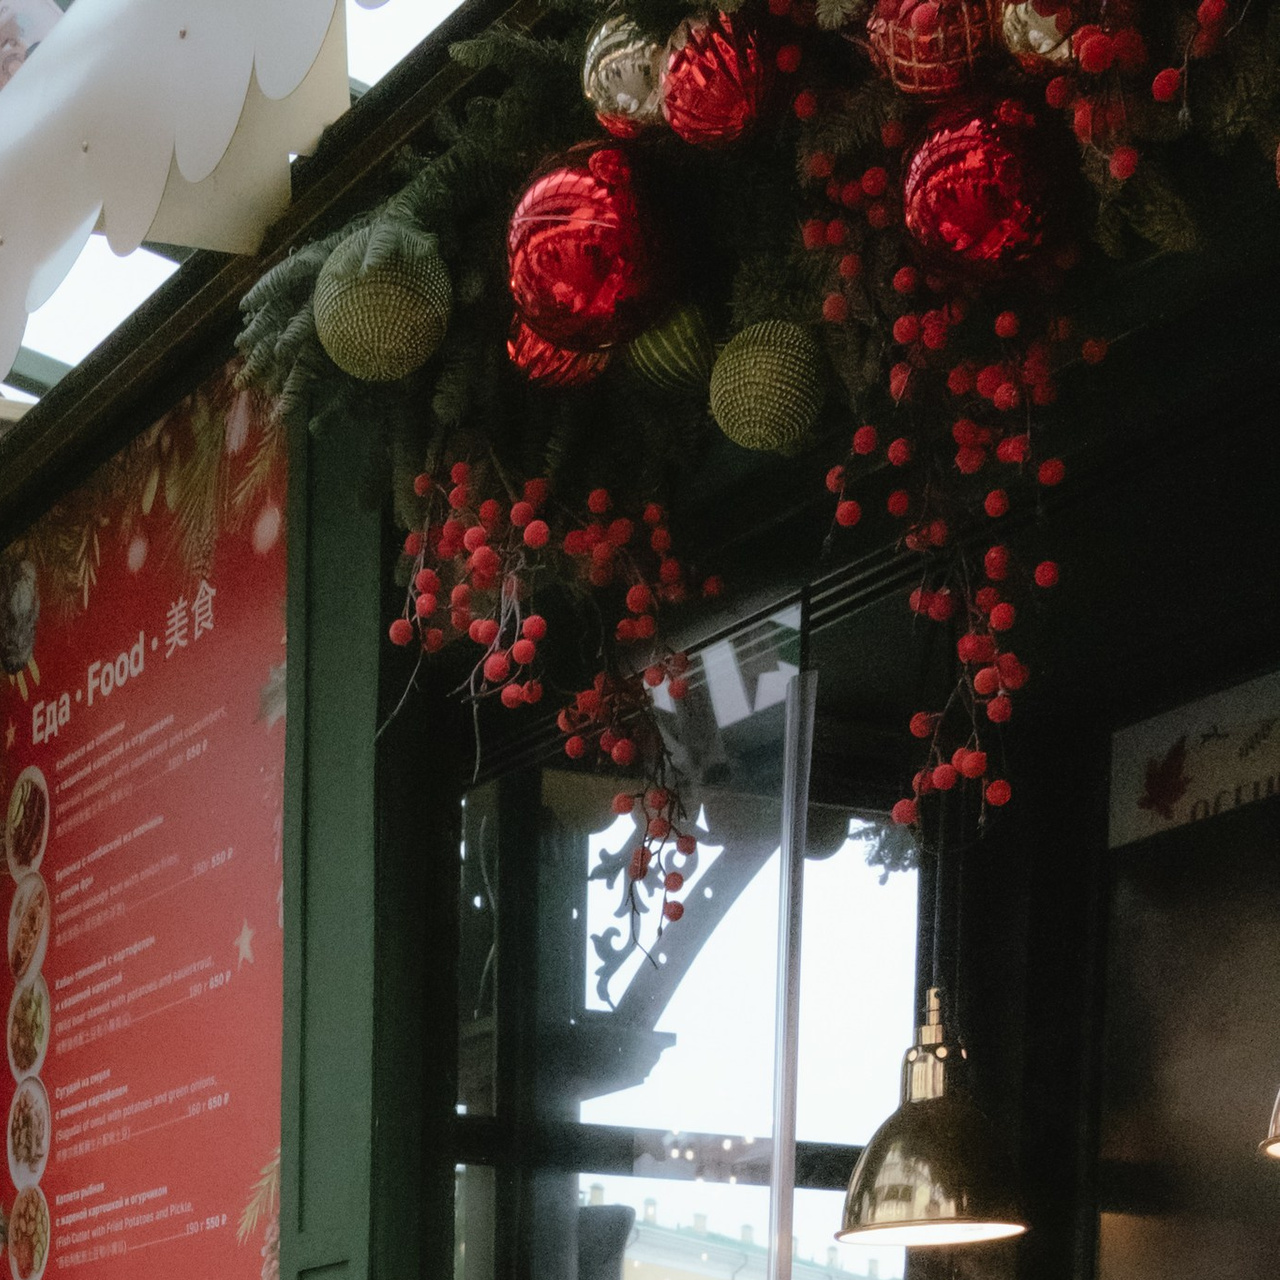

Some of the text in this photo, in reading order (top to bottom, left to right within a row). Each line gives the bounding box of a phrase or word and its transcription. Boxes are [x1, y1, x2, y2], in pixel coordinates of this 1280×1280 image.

[32, 579, 217, 745] Еда Food 美食
[211, 850, 226, 868] 550
[111, 994, 126, 1008] with
[127, 981, 157, 1003] potatoes
[209, 973, 224, 989] 650
[107, 1109, 122, 1121] with
[123, 1098, 152, 1117] potatoes
[153, 1092, 167, 1105] and
[168, 1085, 188, 1103] green
[207, 1095, 222, 1109] 650
[88, 1197, 123, 1216] картошкой
[130, 1186, 167, 1204] огурчиком
[91, 1225, 105, 1237] with
[106, 1220, 123, 1233] Fried
[124, 1213, 153, 1228] Potatoes
[155, 1206, 168, 1220] and
[186, 1221, 199, 1235] 190
[206, 1215, 219, 1229] 550
